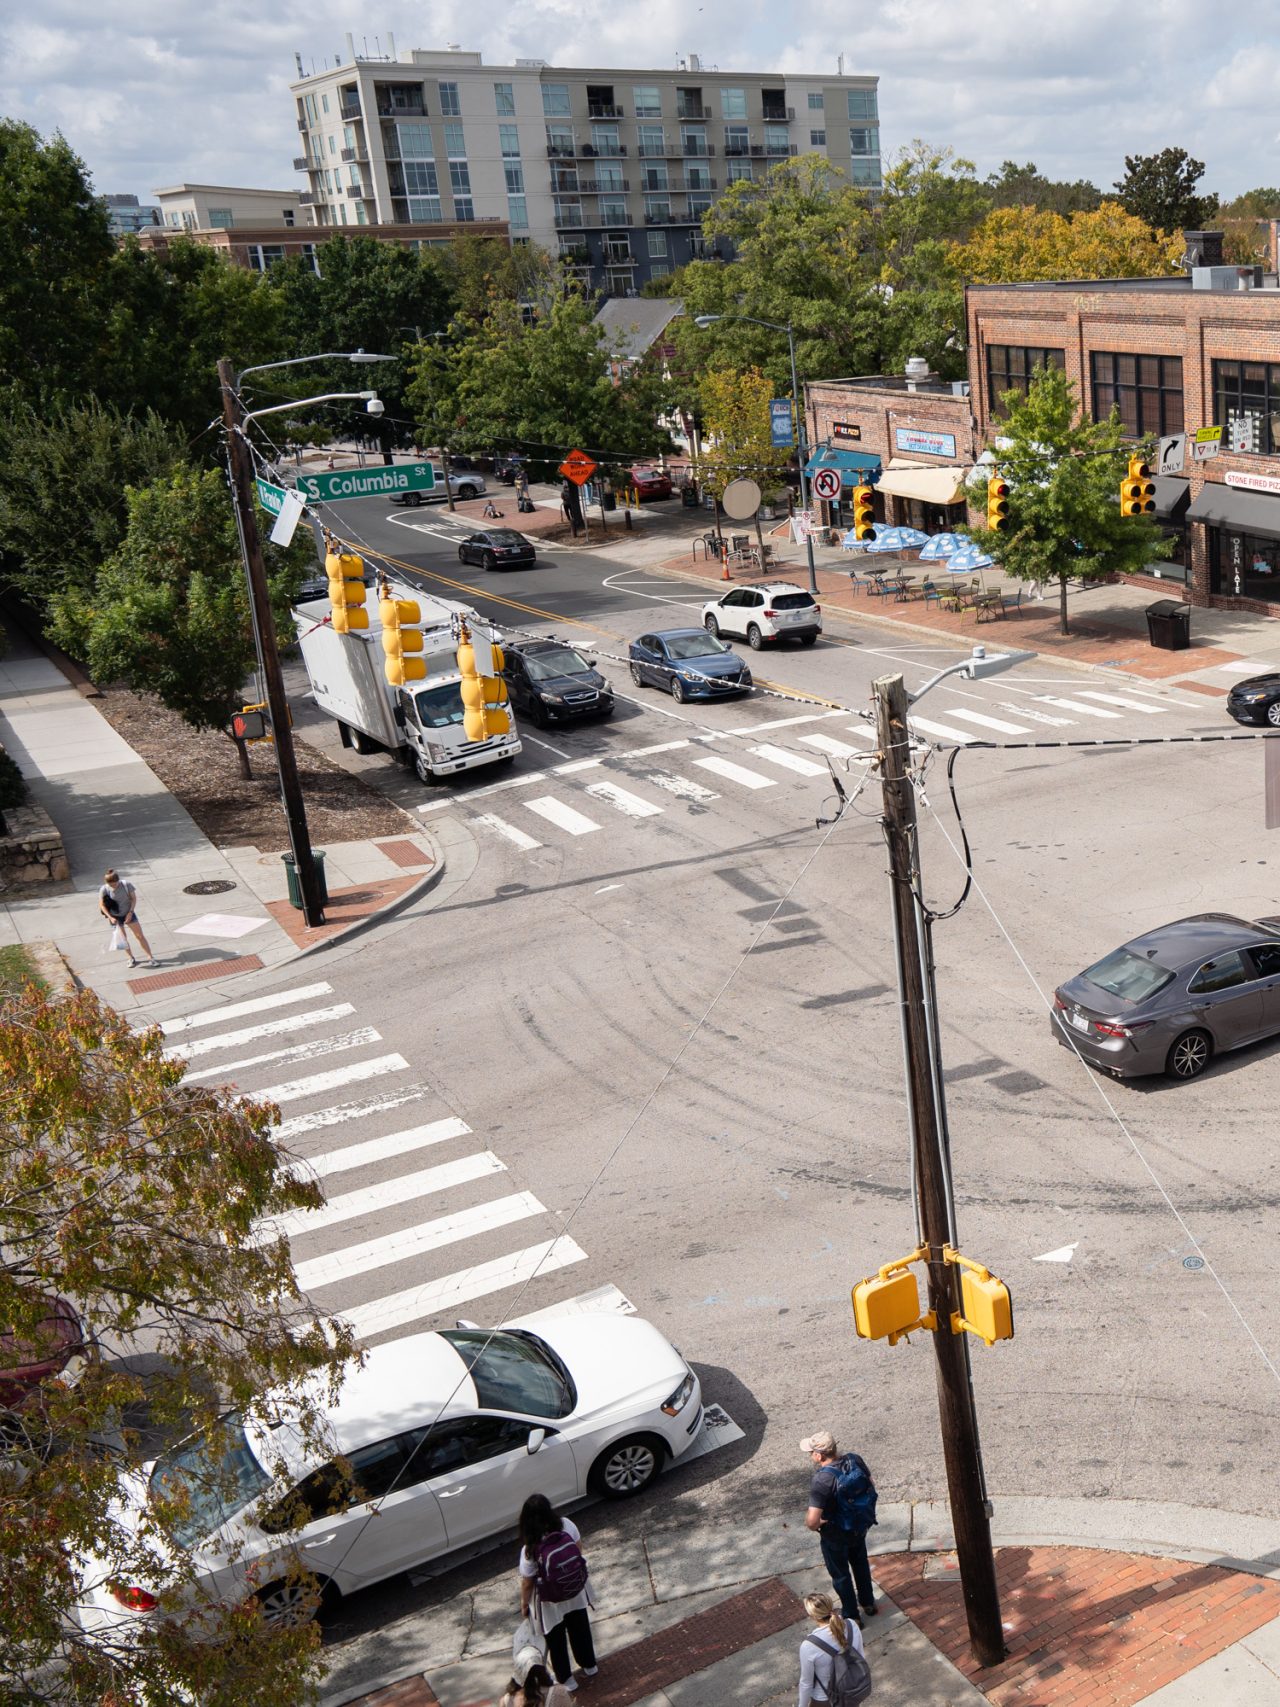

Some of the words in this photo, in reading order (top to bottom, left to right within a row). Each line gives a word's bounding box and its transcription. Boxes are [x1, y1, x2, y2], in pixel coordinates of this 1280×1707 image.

[569, 469, 589, 477] AHEAD
[1161, 461, 1181, 473] ONLY
[307, 478, 325, 499] S.
[328, 472, 409, 496] Columbia
[414, 466, 426, 476] St
[1227, 475, 1248, 485] STONE
[1248, 478, 1268, 488] FIRED
